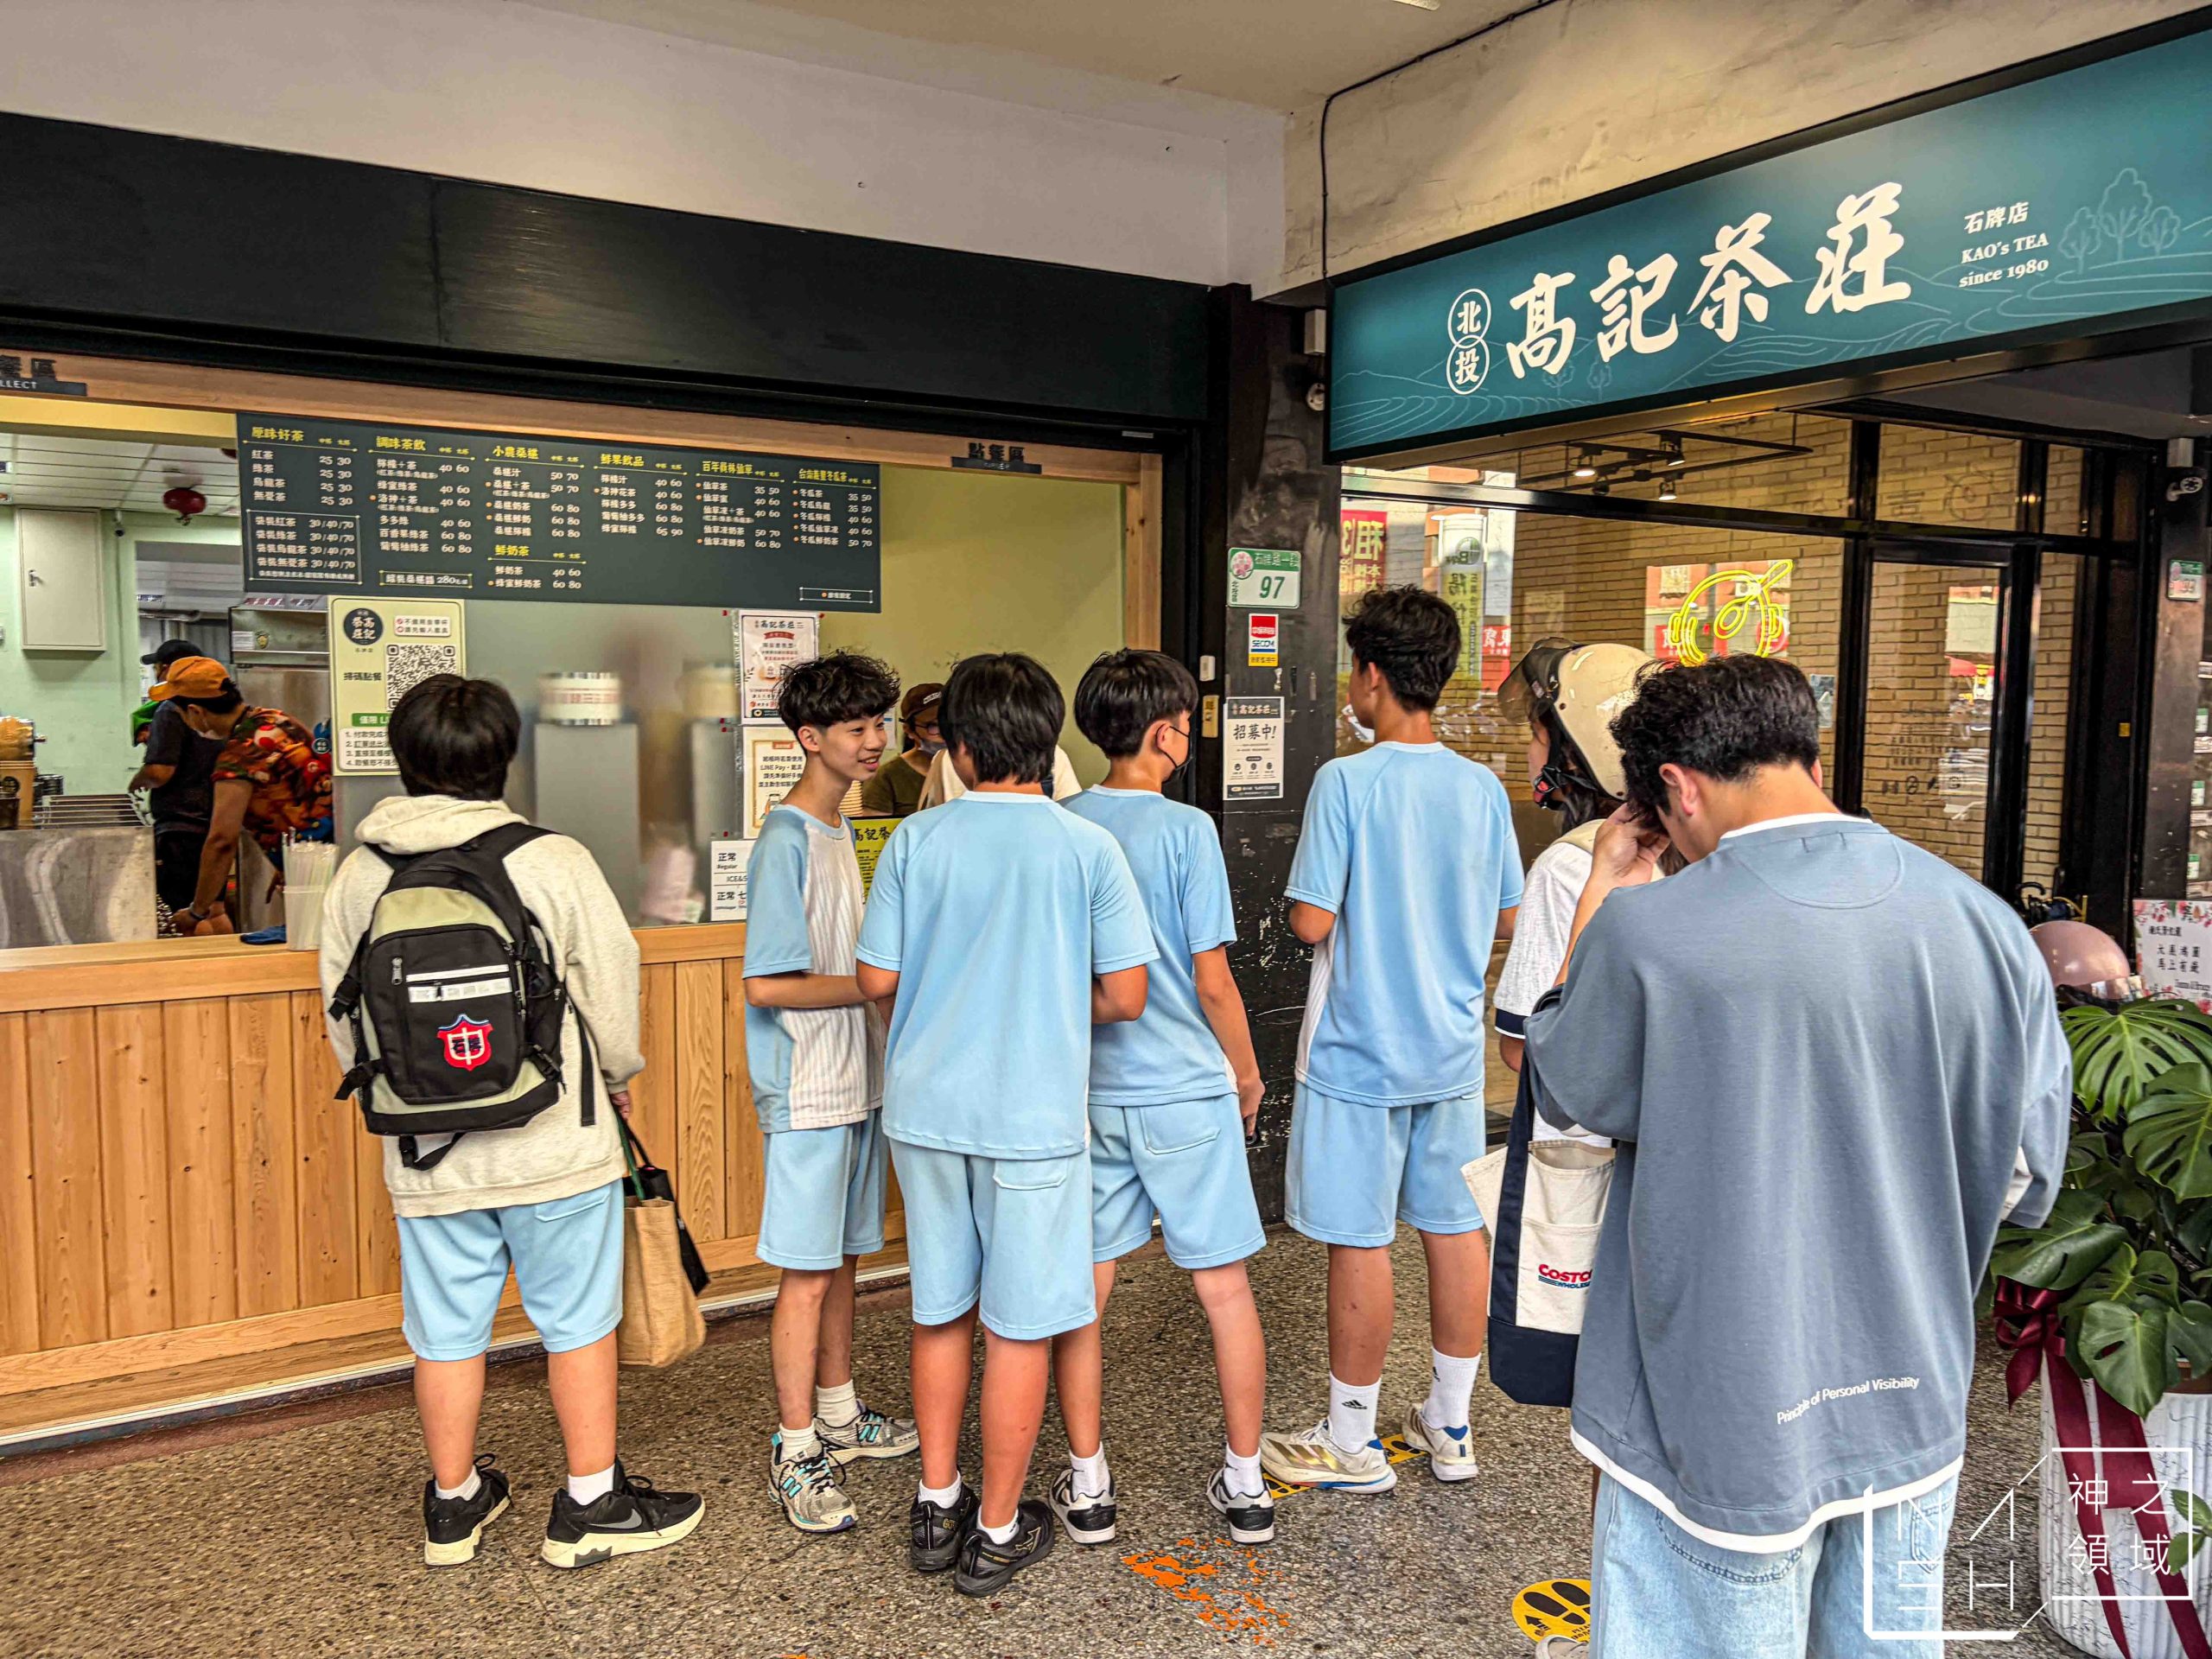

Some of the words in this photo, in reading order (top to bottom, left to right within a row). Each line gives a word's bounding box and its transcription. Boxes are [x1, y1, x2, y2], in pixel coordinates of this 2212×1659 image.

[1964, 201, 2029, 234] 石牌店
[2013, 232, 2049, 252] TEA
[1959, 268, 2001, 289] since
[2005, 258, 2049, 280] 1980
[1455, 301, 1481, 385] 北投
[1260, 575, 1286, 599] 97
[1252, 639, 1274, 648] SECOM
[1539, 1264, 1592, 1283] COSTC
[1810, 1391, 1821, 1406] of
[1822, 1380, 1870, 1401] Personal
[1872, 1376, 1920, 1391] Visibility
